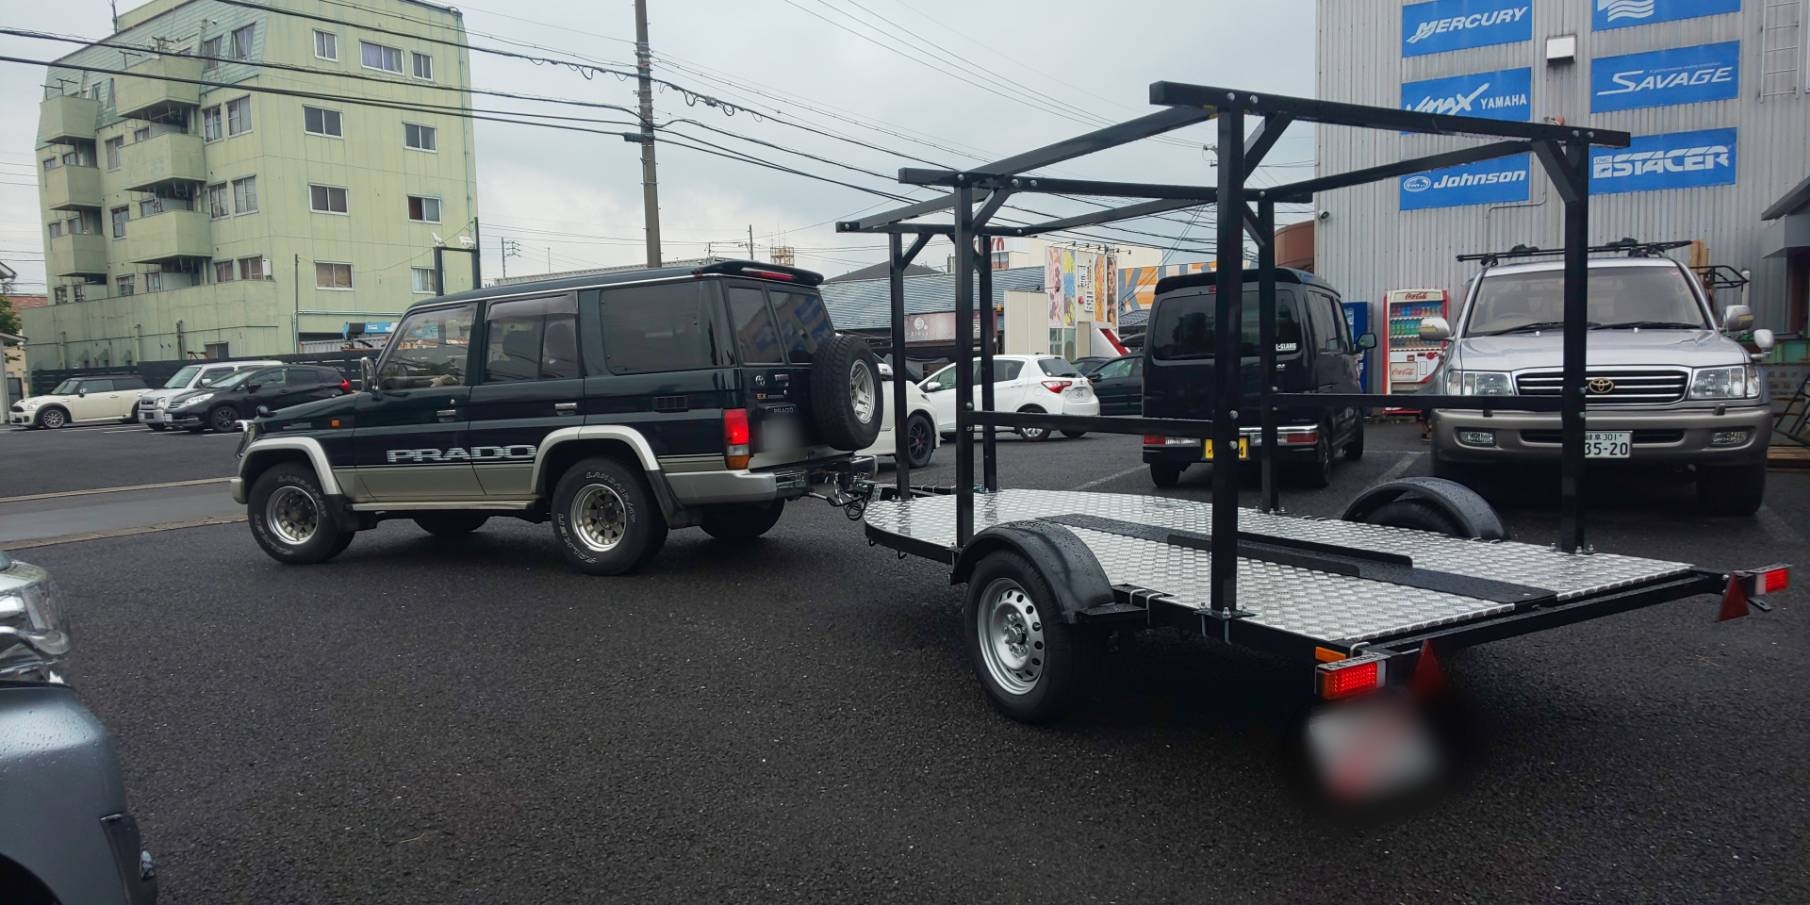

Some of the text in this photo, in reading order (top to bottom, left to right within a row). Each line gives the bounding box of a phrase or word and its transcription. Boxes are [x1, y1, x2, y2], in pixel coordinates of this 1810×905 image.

[1406, 6, 1528, 43] MERCURY
[1597, 66, 1733, 96] SAVAGE
[1480, 93, 1528, 110] YAMAHA
[1433, 169, 1526, 189] Johnson
[387, 445, 537, 463] PRADO
